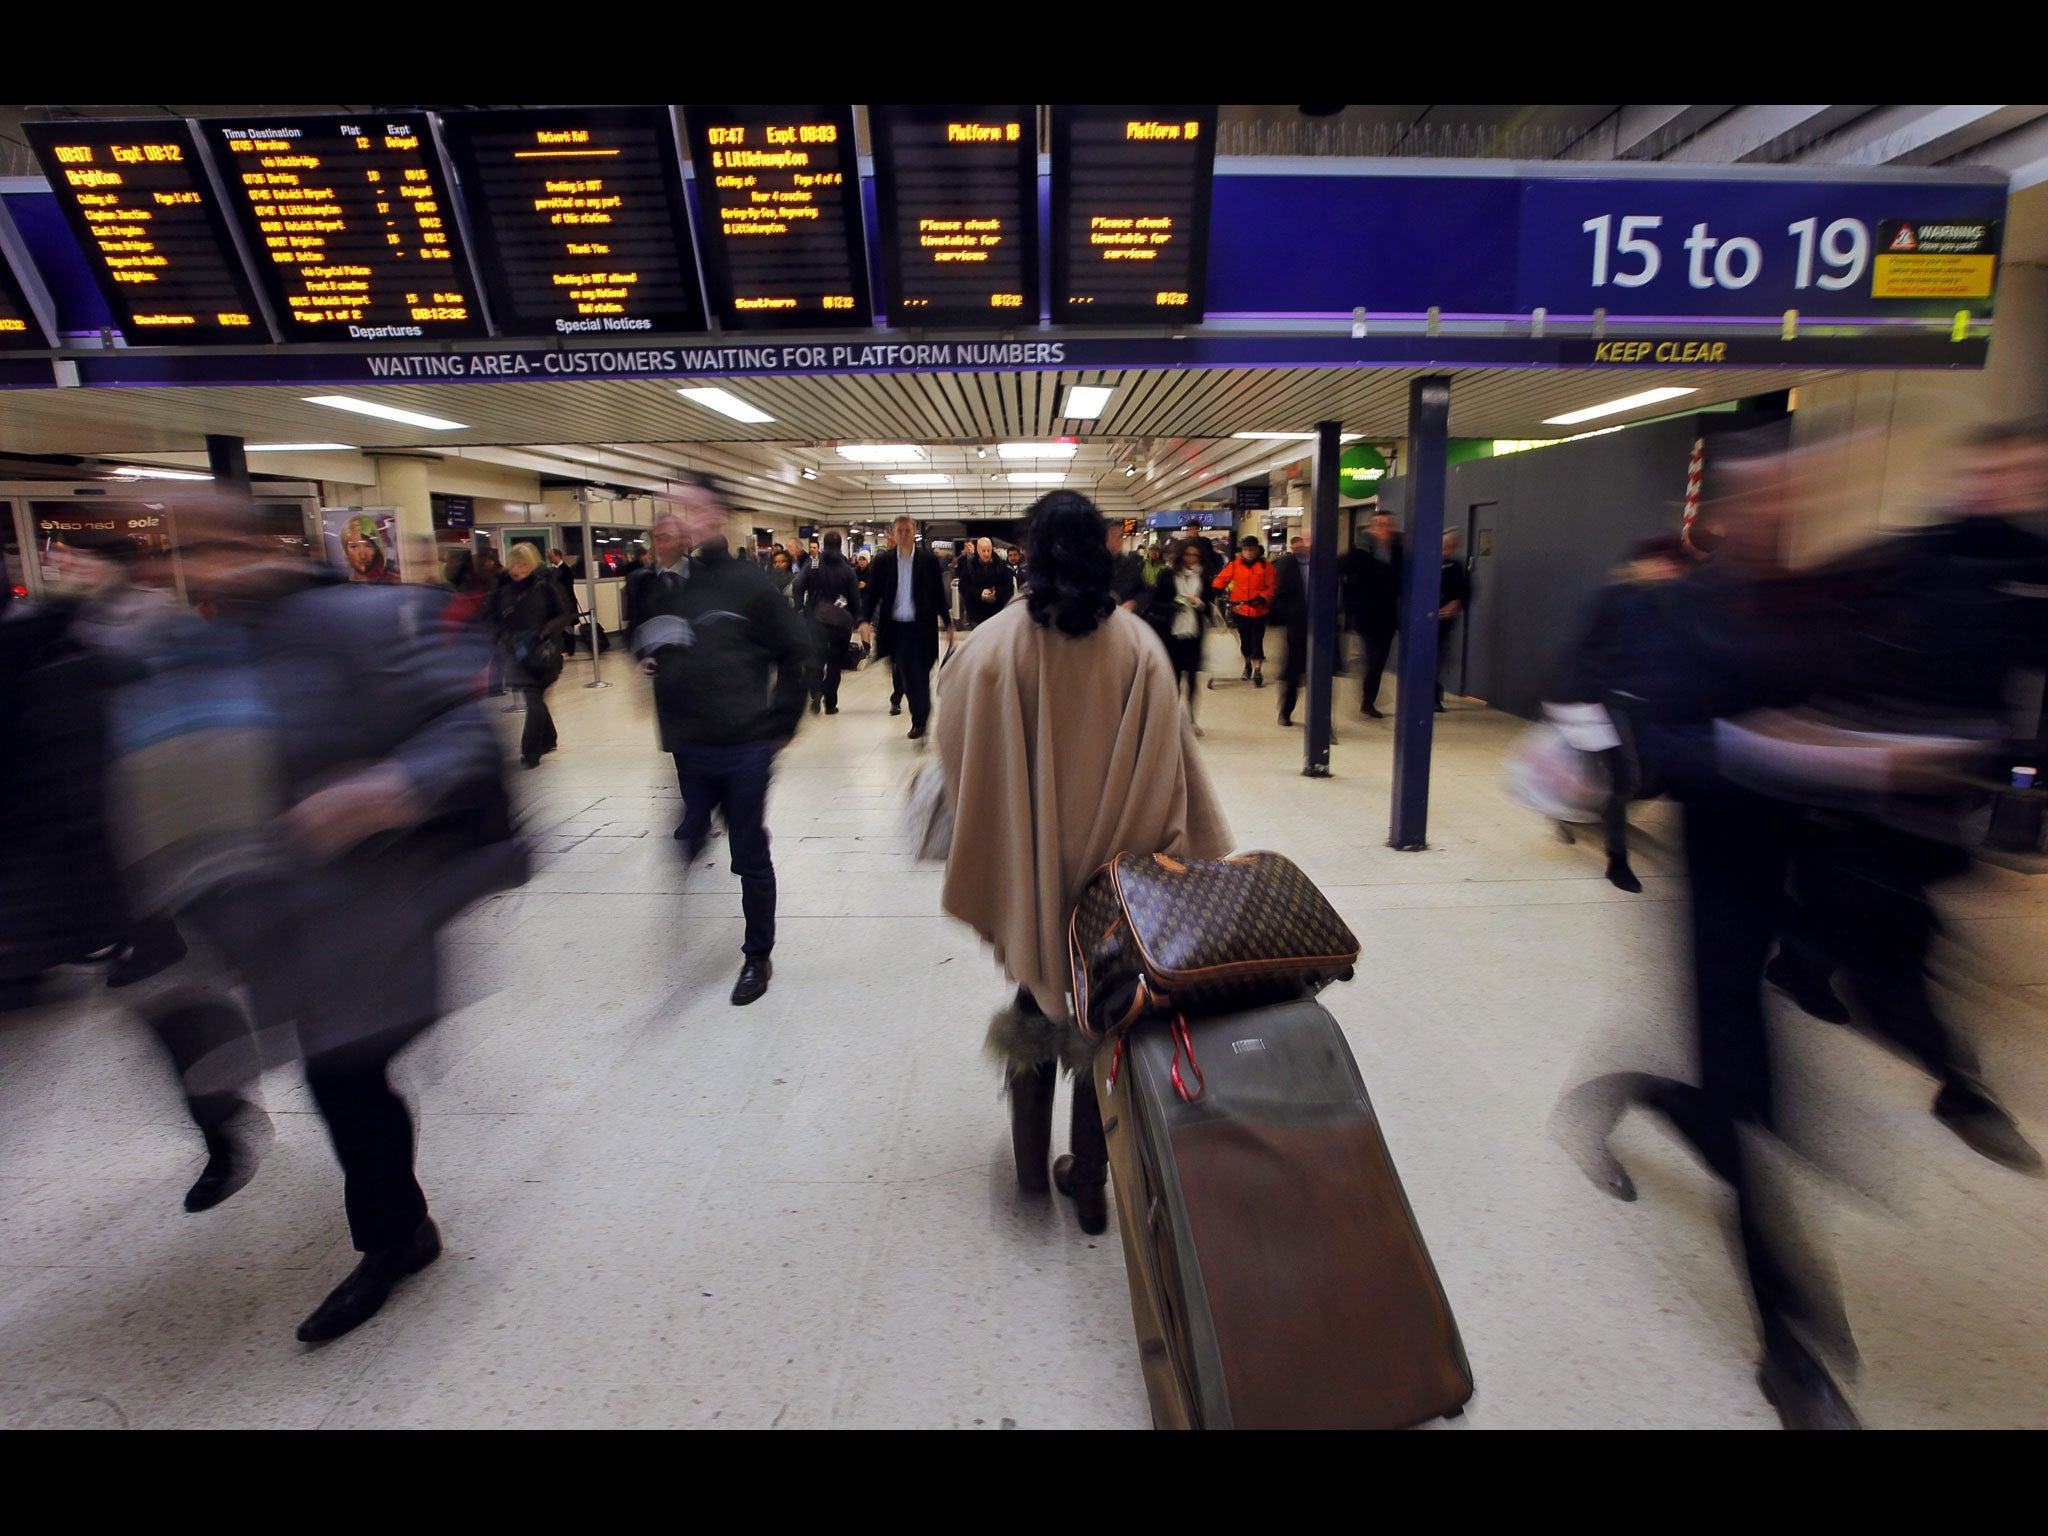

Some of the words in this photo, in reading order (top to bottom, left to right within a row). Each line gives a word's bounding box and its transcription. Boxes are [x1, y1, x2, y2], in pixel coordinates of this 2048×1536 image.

[222, 129, 247, 139] Time
[248, 127, 302, 139] Destination
[341, 125, 361, 136] Plat
[387, 124, 411, 136] Expt
[708, 127, 745, 144] 07:47
[799, 125, 837, 142] 08:03
[948, 124, 1002, 141] Platform
[1126, 122, 1180, 139] Platform
[254, 140, 291, 150] Horsham
[385, 136, 419, 149] Delayed
[537, 132, 571, 143] Network
[571, 131, 589, 142] Rail
[55, 147, 93, 162] 08:07
[144, 145, 184, 161] 08:12
[713, 151, 724, 167] &
[725, 150, 808, 168] Littlehampton
[65, 170, 123, 187] Brighton
[266, 173, 299, 185] Dorking
[716, 176, 743, 188] Calling
[794, 174, 814, 187] Page
[823, 173, 834, 185] of
[272, 189, 303, 199] Gatwick
[400, 186, 433, 198] Delayed
[546, 181, 576, 193] Smoking
[586, 180, 602, 191] NOT
[77, 194, 106, 206] Calling
[154, 193, 173, 205] Page
[182, 193, 192, 203] of
[780, 190, 812, 202] coaches
[535, 197, 573, 211] permitted
[574, 199, 585, 208] on
[586, 199, 601, 209] any
[84, 210, 117, 221] Clapham
[117, 209, 152, 220] Junction
[287, 205, 342, 216] Littlehampton
[552, 213, 562, 224] of
[563, 212, 580, 224] this
[1091, 217, 1134, 228] Please
[1135, 217, 1172, 228] check
[91, 226, 111, 236] East
[111, 225, 146, 237] Croydon
[284, 221, 315, 231] Gatwick
[920, 219, 962, 231] Please
[964, 219, 1000, 230] check
[1090, 232, 1148, 244] timetable
[1150, 232, 1173, 244] for
[1918, 226, 1985, 239] WARNING
[289, 237, 325, 248] Brighton
[920, 235, 977, 246] timetable
[980, 234, 1002, 246] for
[98, 241, 123, 251] Three
[123, 241, 154, 252] Bridges
[567, 244, 592, 254] Thank
[1582, 214, 1663, 287] 15
[1683, 223, 1763, 289] to
[1787, 217, 1871, 291] 19
[295, 252, 325, 262] Sutton
[420, 249, 433, 259] On
[433, 249, 451, 259] time
[934, 250, 988, 261] services
[1103, 248, 1158, 259] services
[105, 257, 142, 268] Haywards
[142, 256, 168, 266] Heath
[315, 266, 343, 278] Crystal
[344, 265, 372, 275] Palace
[553, 274, 582, 286] Smoking
[591, 273, 607, 283] NOT
[608, 272, 637, 283] allowed
[306, 281, 329, 291] Front
[338, 281, 369, 291] coaches
[312, 296, 341, 306] Gatwick
[433, 293, 445, 303] On
[445, 292, 463, 303] time
[570, 291, 581, 299] on
[582, 290, 596, 300] any
[595, 288, 628, 298] National
[578, 303, 594, 313] Rail
[735, 298, 796, 309] Southern
[133, 315, 195, 325] Southern
[294, 311, 324, 322] Page
[326, 310, 334, 320] 1
[336, 310, 349, 320] of
[351, 310, 363, 319] 2
[411, 308, 468, 320] 08:12:32
[556, 318, 600, 334] Special
[603, 317, 651, 330] Notices
[349, 325, 422, 339] Departures
[1594, 341, 1653, 362] KEEP
[1655, 341, 1726, 363] CLEAR
[367, 355, 464, 377] WAITING
[681, 347, 777, 370] WAITING
[783, 346, 828, 367] FOR
[832, 344, 949, 367] PLATFORM
[957, 343, 1065, 364] NUMBERS
